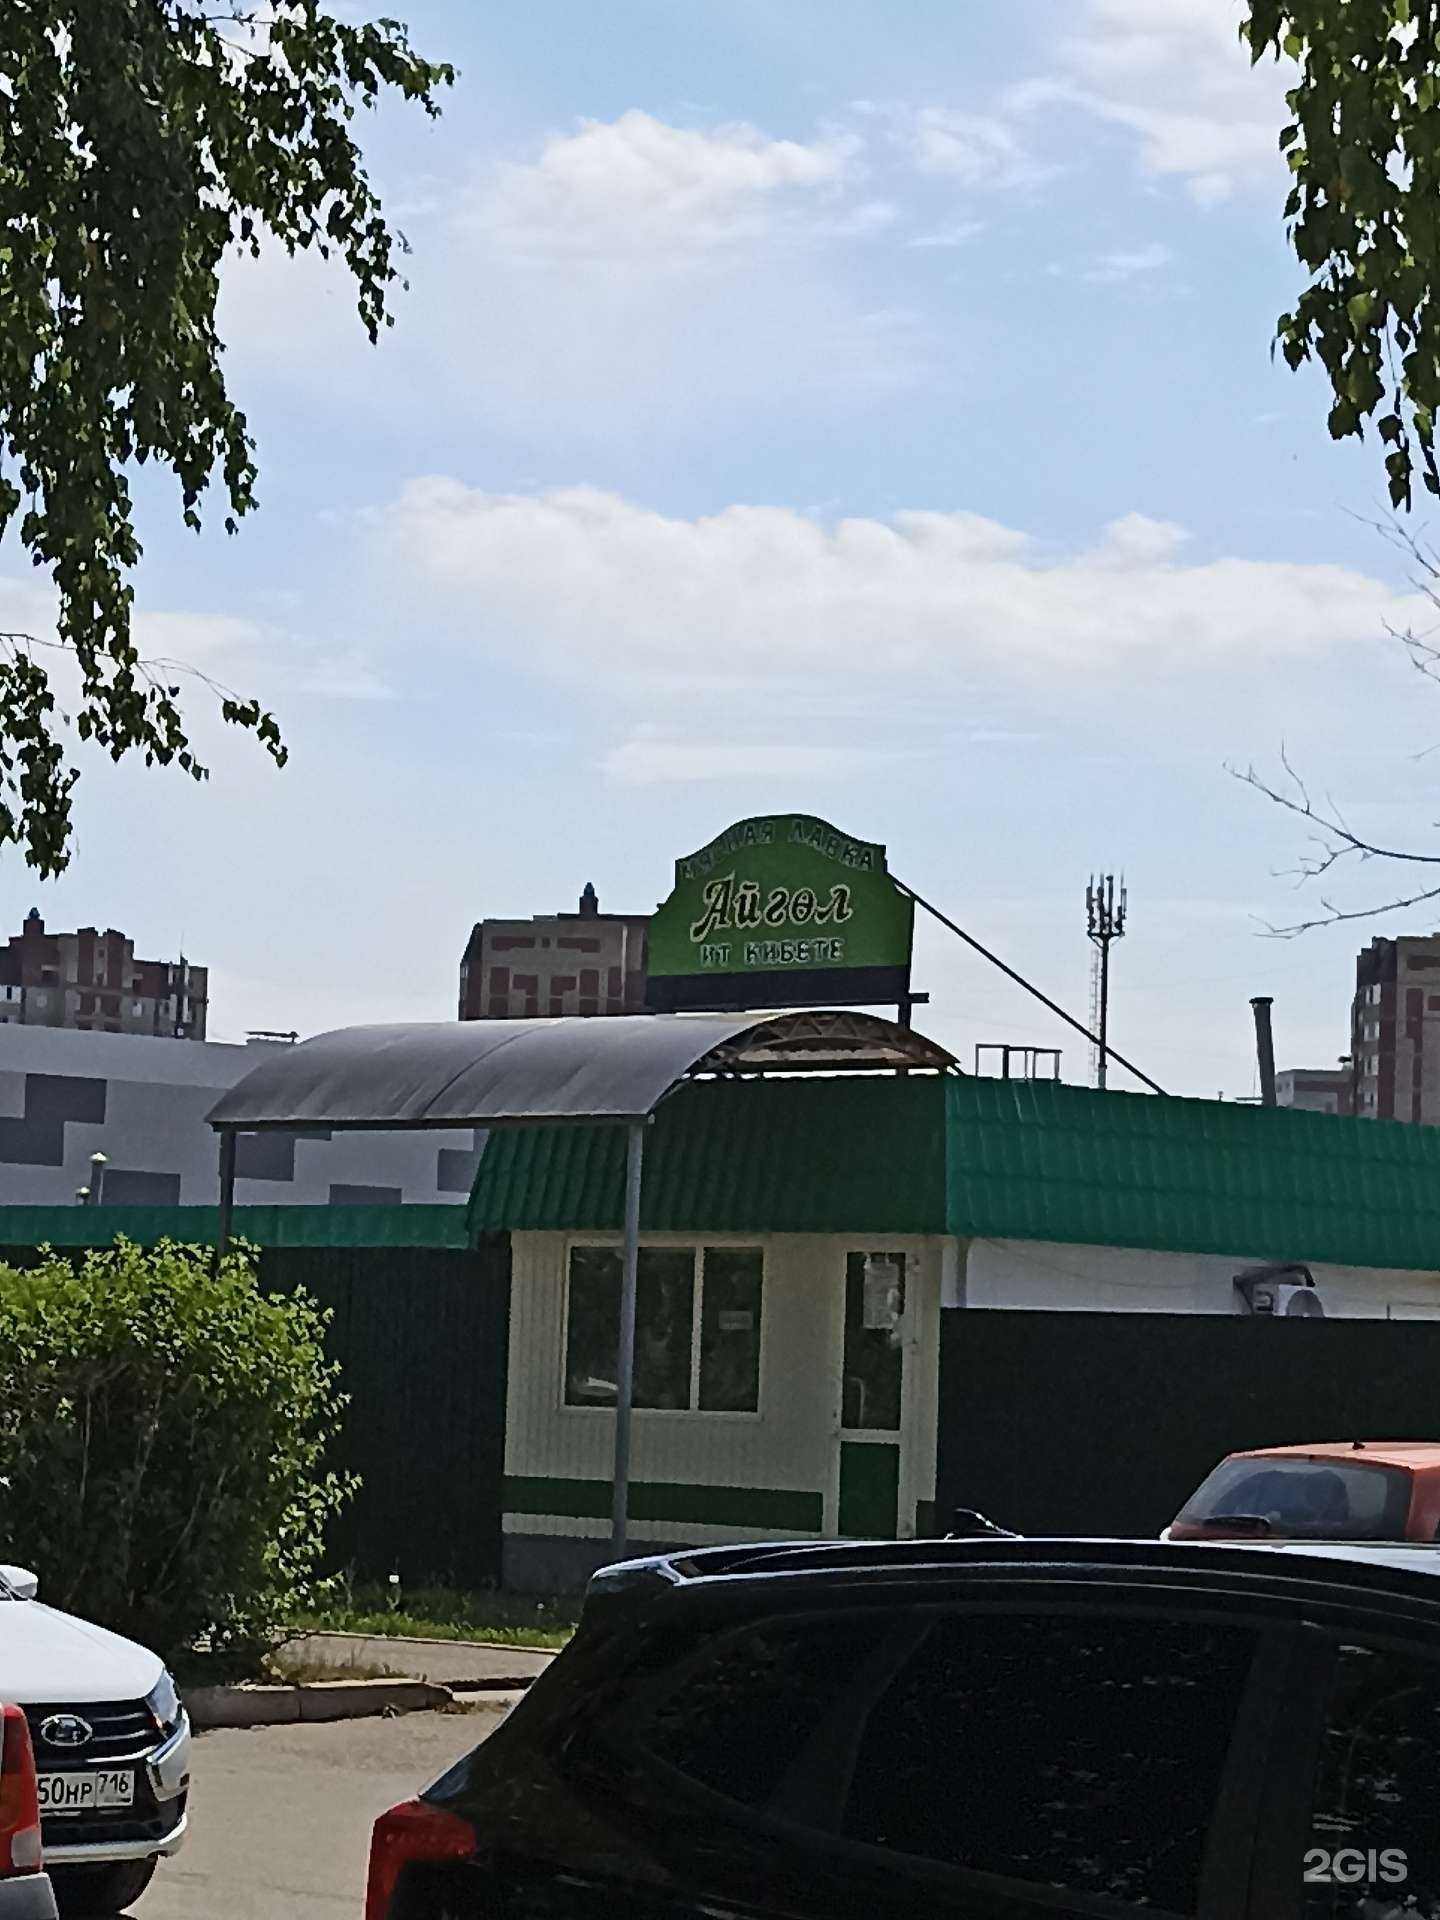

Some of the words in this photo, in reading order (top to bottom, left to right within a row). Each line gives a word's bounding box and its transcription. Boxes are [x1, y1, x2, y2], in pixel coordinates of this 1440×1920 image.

[788, 818, 875, 872] ЛАВКА
[690, 870, 853, 942] Айгөл
[701, 943, 732, 966] ИТ
[744, 937, 845, 966] КИБЕТЕ
